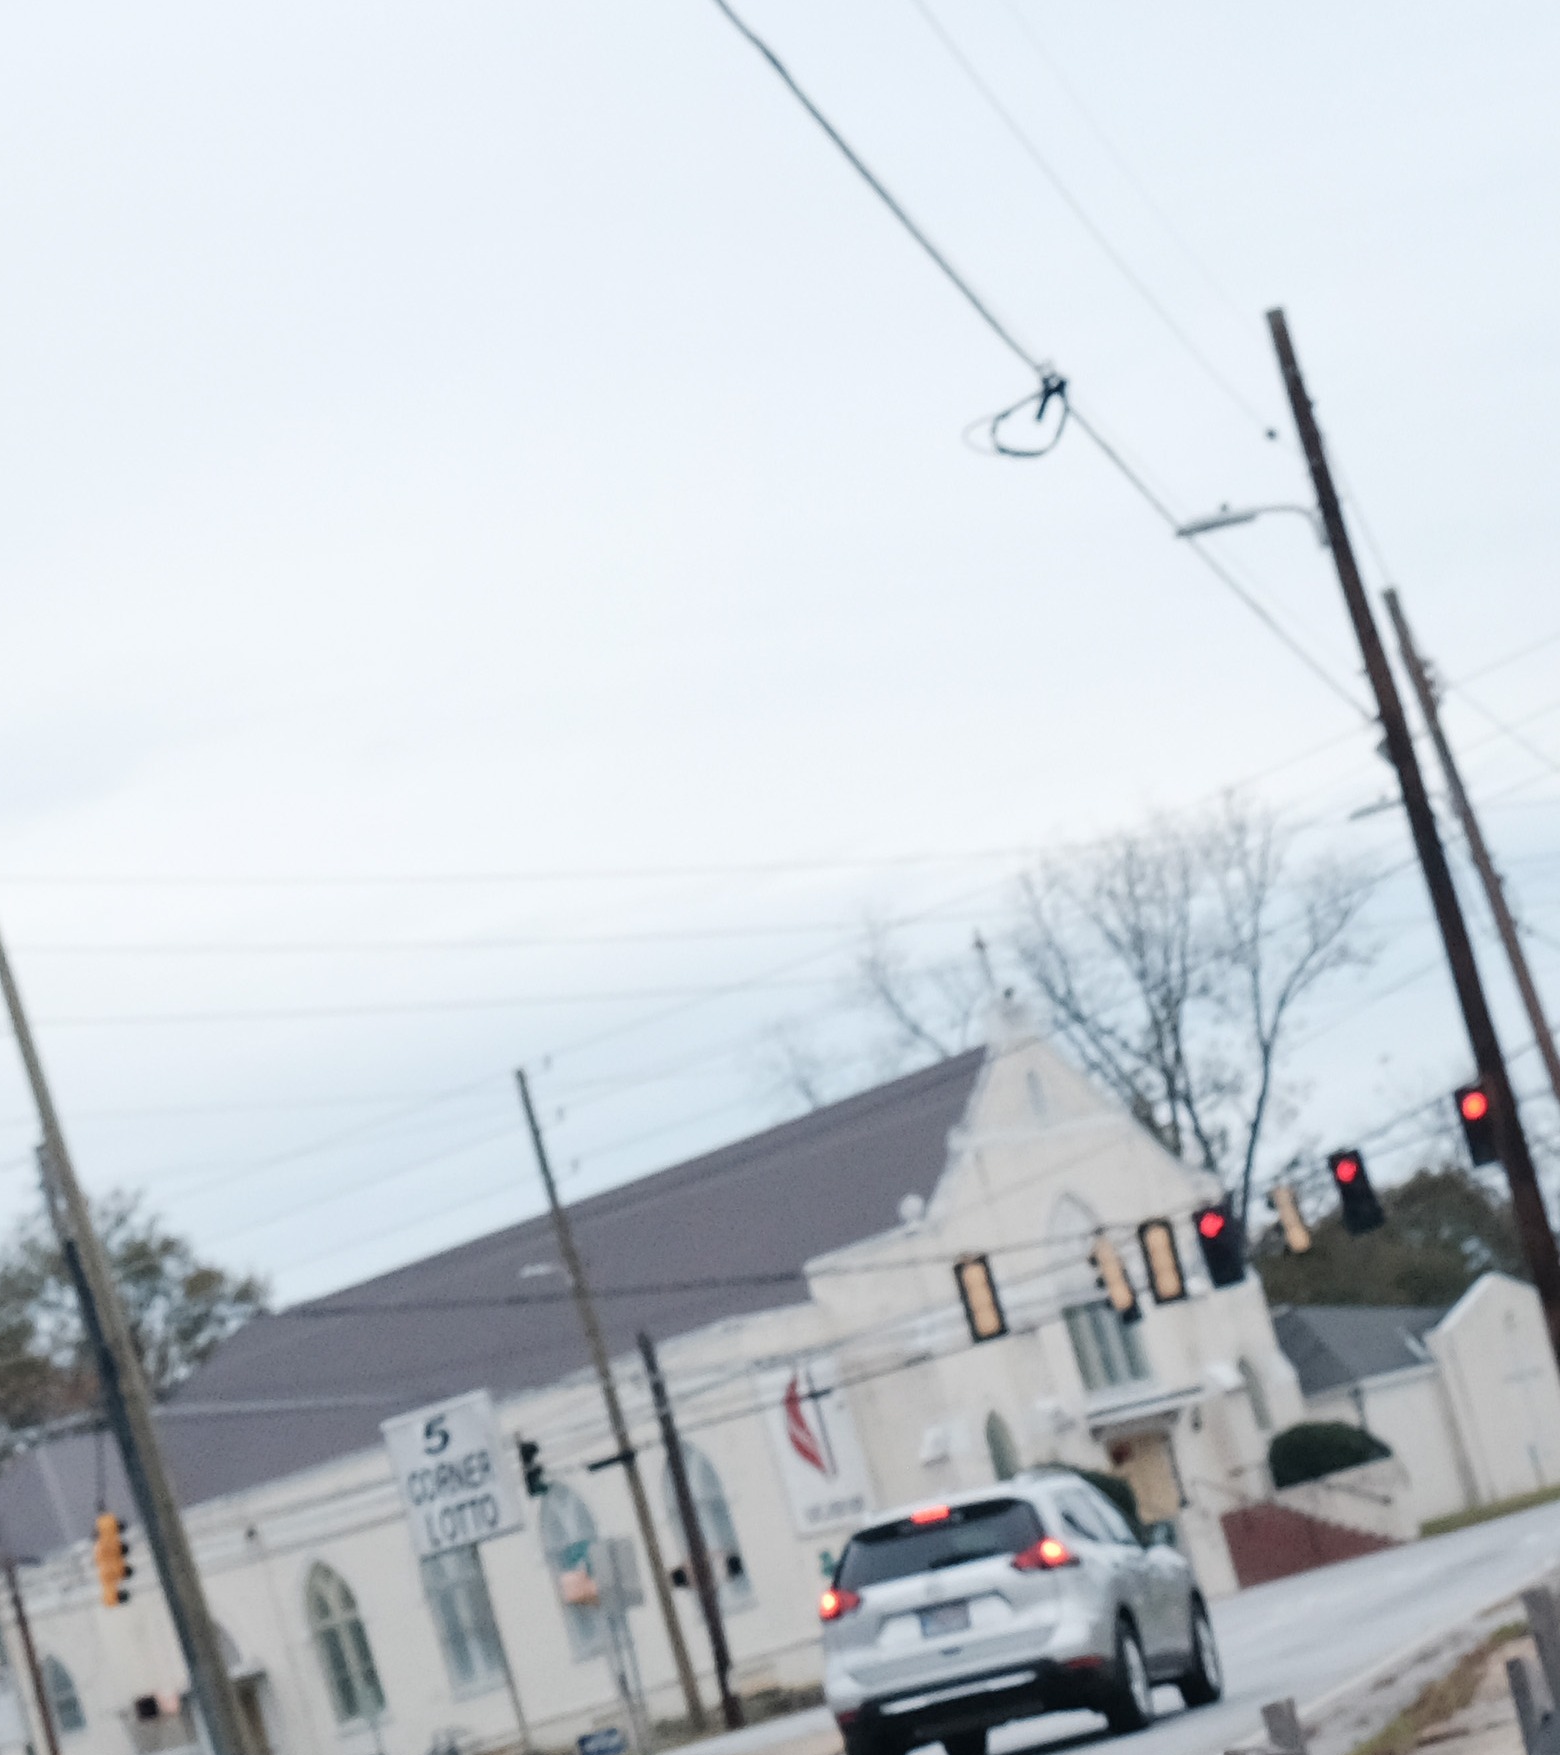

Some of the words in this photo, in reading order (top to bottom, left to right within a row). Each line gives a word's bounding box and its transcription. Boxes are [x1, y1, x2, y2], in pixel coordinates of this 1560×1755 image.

[423, 1412, 450, 1456] 5
[406, 1449, 492, 1506] CORNER
[424, 1493, 500, 1548] LOTTO
